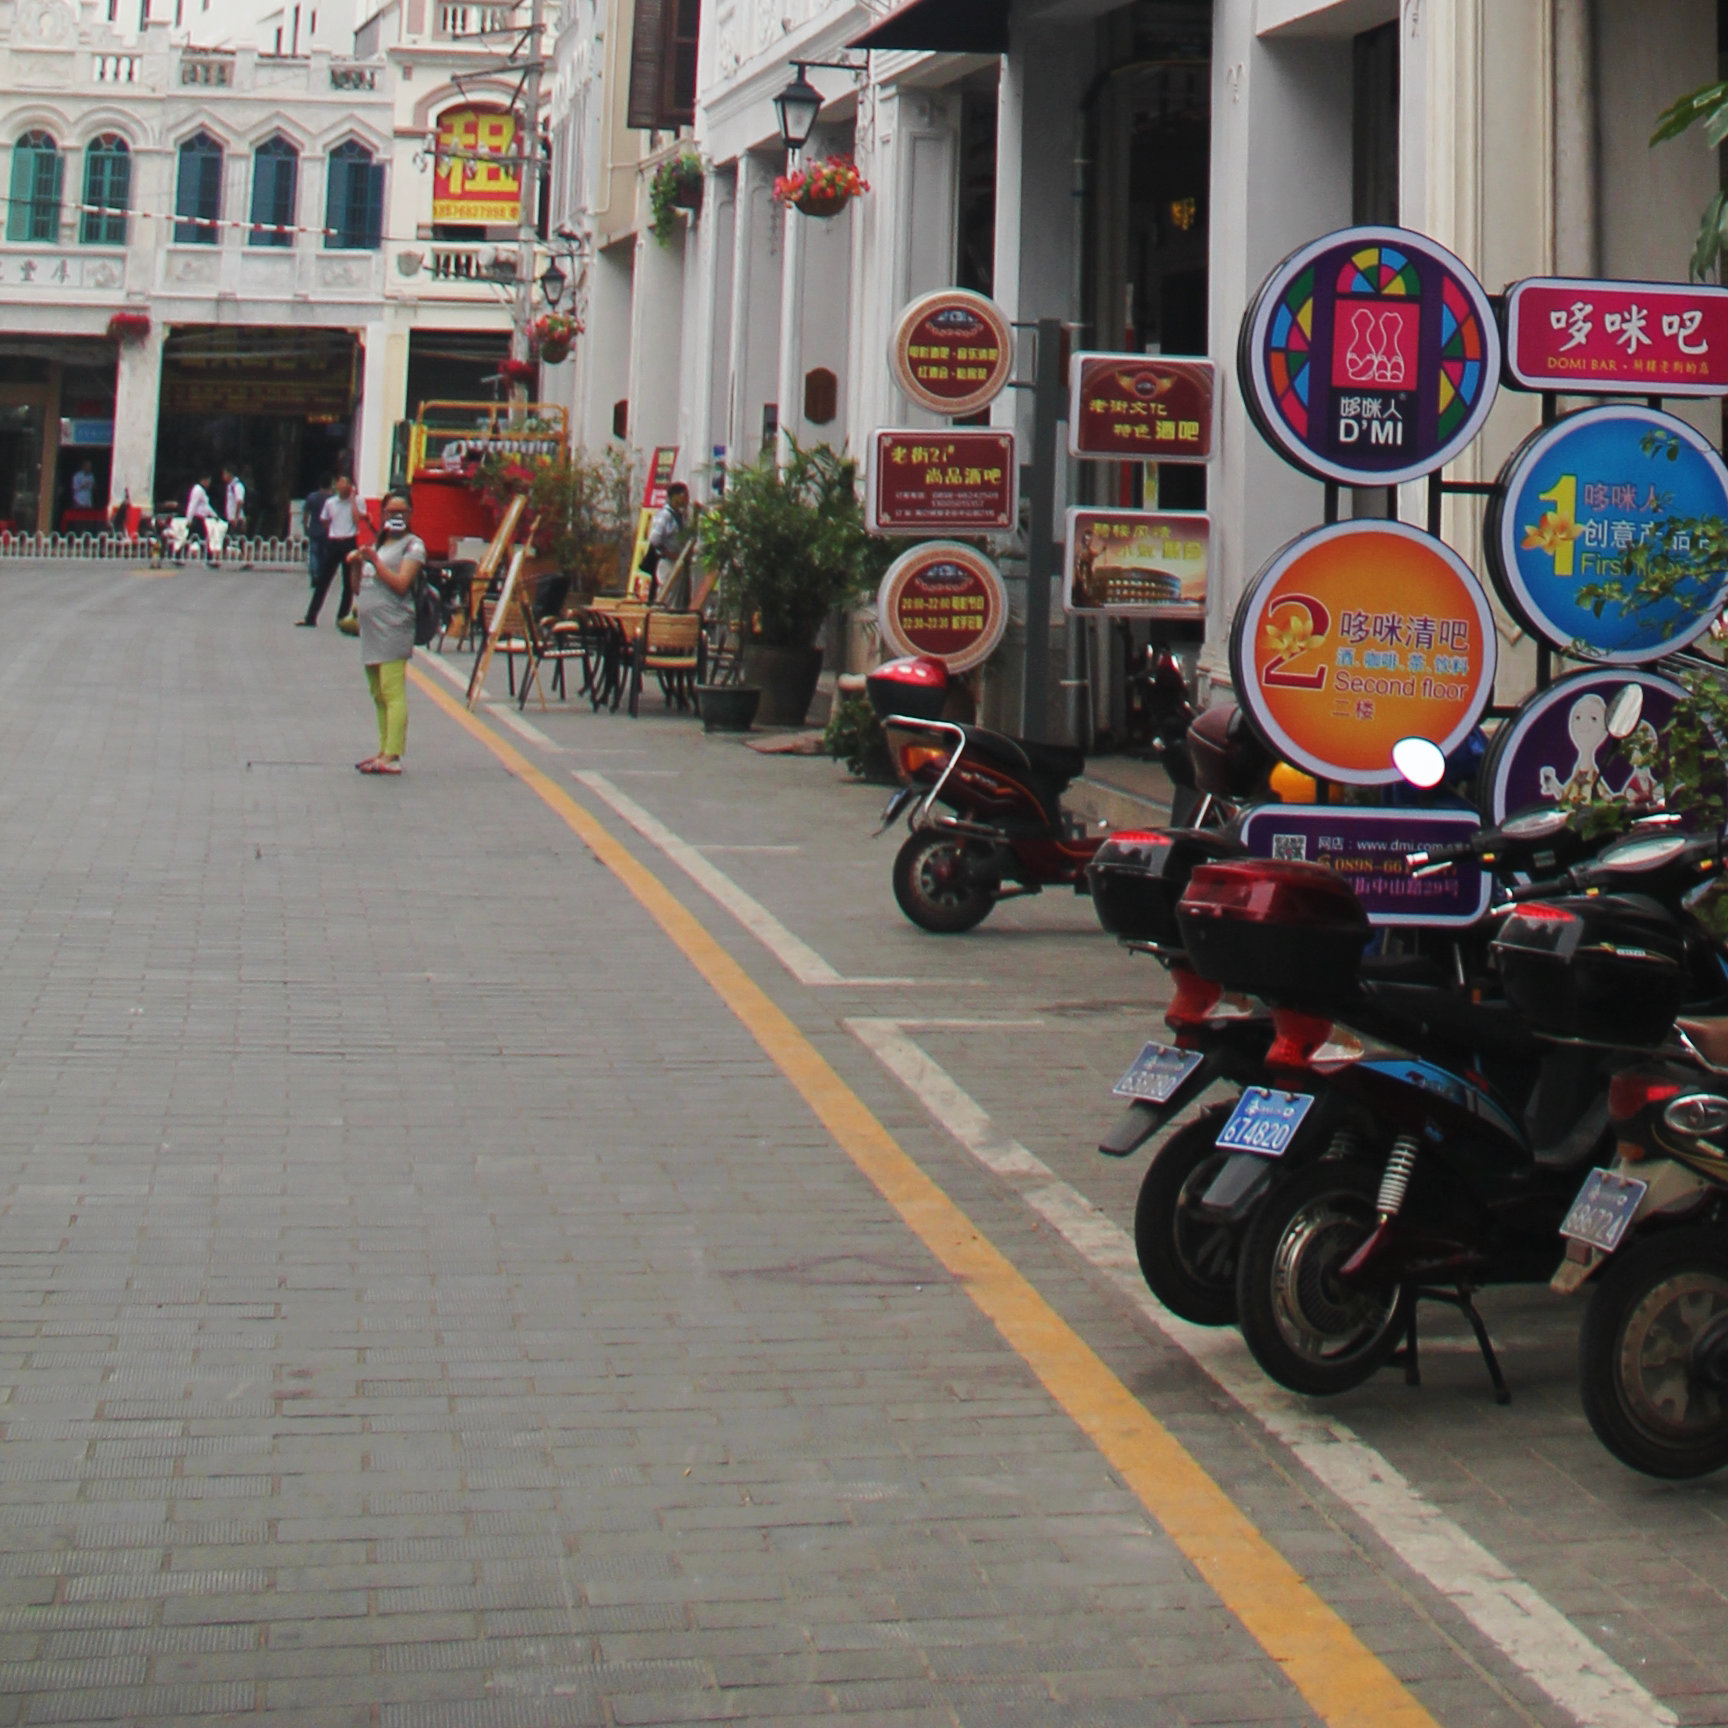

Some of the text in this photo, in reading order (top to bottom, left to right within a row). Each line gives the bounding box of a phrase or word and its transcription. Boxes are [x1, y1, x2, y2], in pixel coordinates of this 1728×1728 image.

[437, 110, 519, 194] 租
[1550, 301, 1709, 355] 哆咪吧
[1547, 356, 1586, 370] DOMI
[1591, 358, 1617, 372] BAR
[1340, 396, 1403, 420] 哆咪人
[1339, 418, 1403, 446] D'MI
[925, 467, 1002, 486] 尚品酒吧
[1584, 482, 1663, 513] 哆咪人
[1339, 611, 1469, 652] 哆咪清吧
[1334, 670, 1468, 700] Second floor
[1332, 699, 1375, 720] 二楼
[1224, 1117, 1290, 1150] 674820
